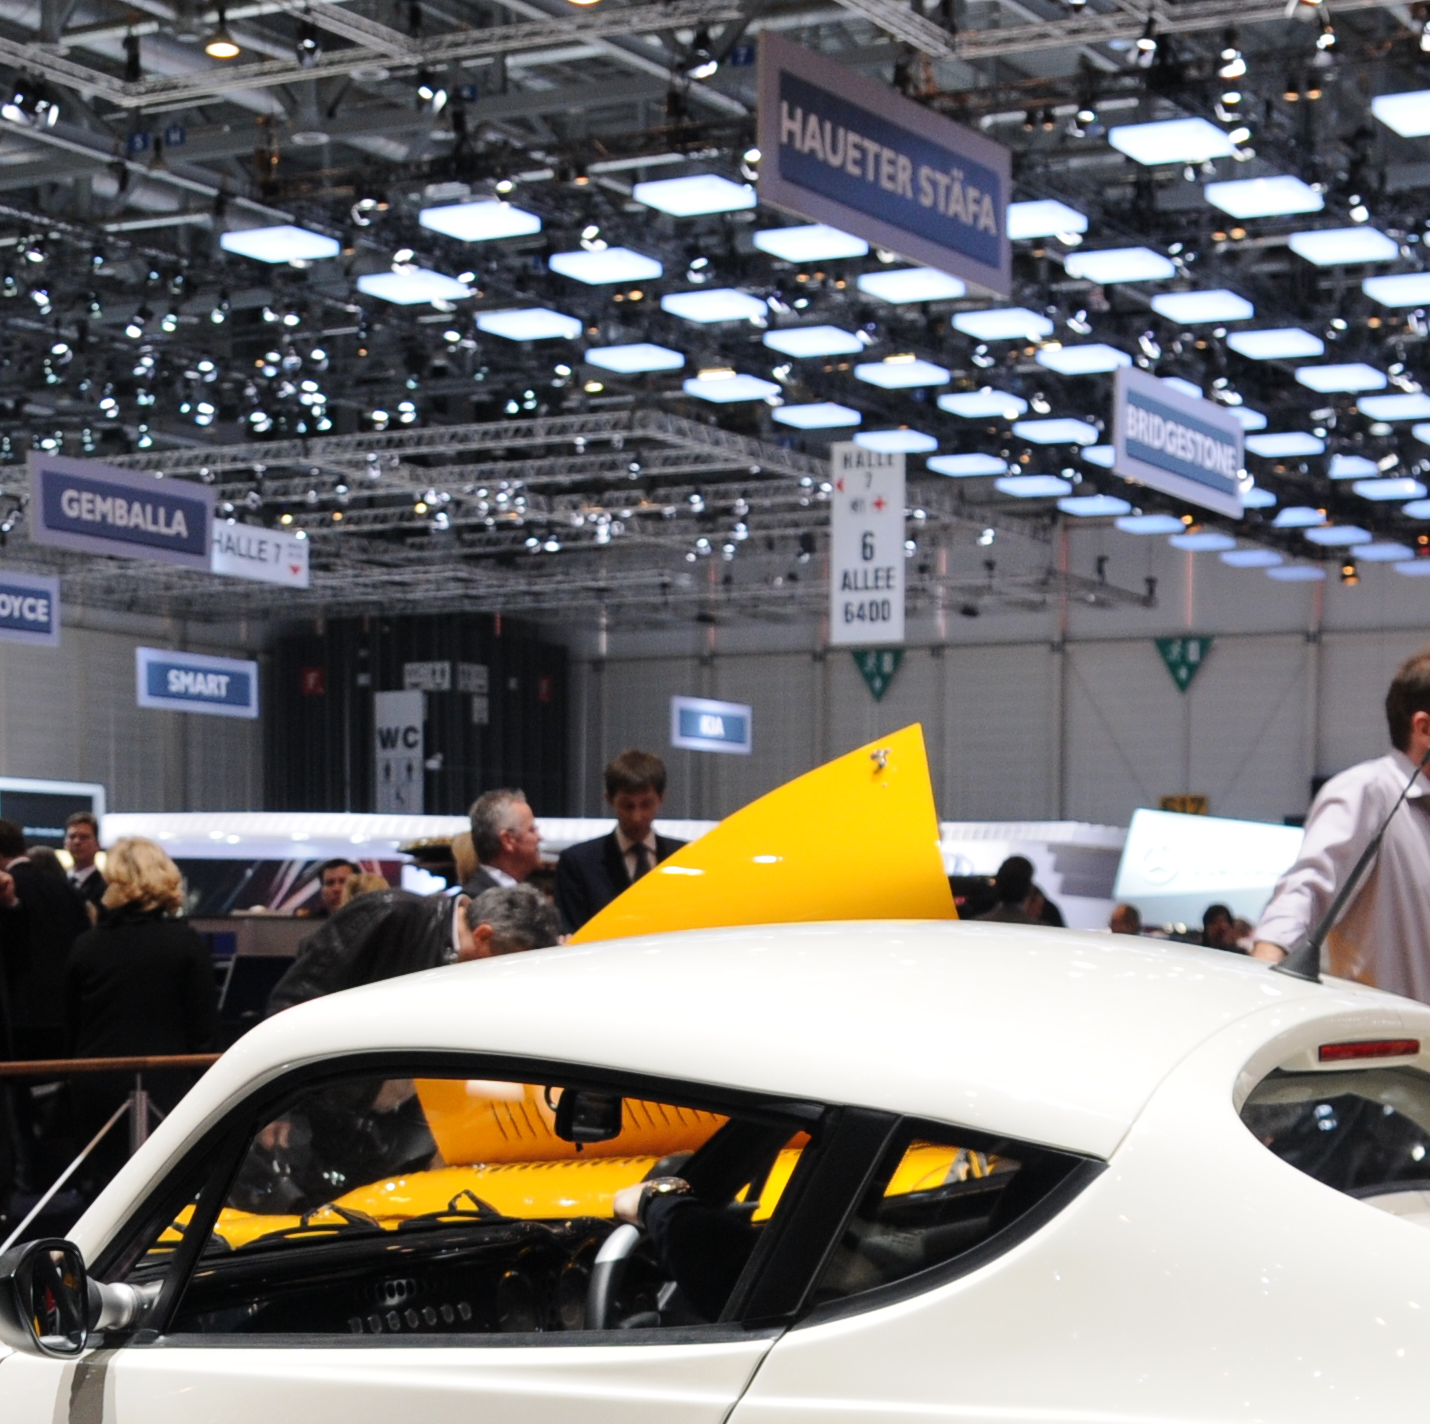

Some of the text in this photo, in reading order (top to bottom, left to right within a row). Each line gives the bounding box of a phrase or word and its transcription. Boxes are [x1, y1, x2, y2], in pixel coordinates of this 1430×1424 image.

[780, 100, 998, 238] HAUETER STÄFA
[1126, 402, 1237, 479] BRIDGESTONE
[60, 488, 189, 539] GEMBALLA
[861, 533, 875, 561] 6
[841, 567, 895, 592] ALLEE
[844, 600, 891, 624] 6400
[167, 668, 231, 699] SMART
[378, 725, 419, 749] WC
